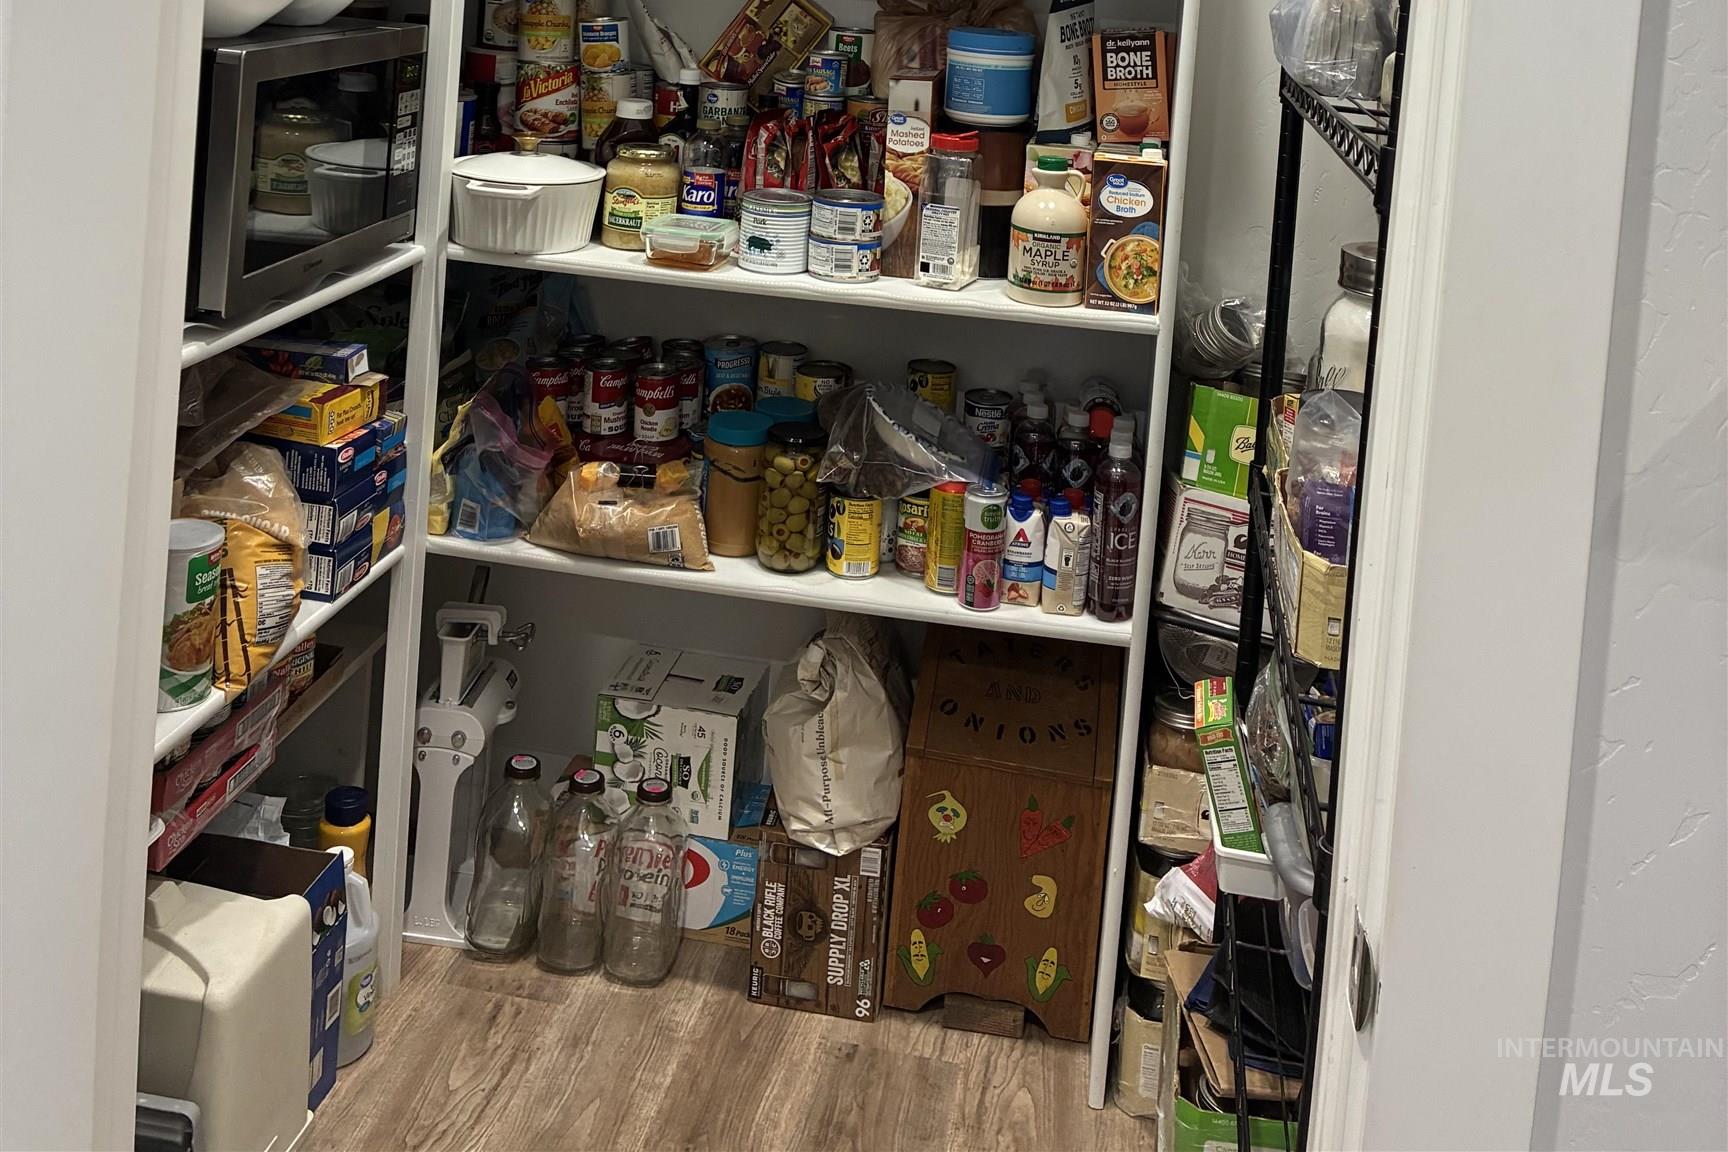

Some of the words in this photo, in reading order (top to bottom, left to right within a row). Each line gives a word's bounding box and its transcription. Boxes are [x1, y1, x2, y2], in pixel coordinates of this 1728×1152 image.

[1060, 22, 1079, 43] BONE
[838, 43, 858, 53] Beets
[1106, 39, 1117, 48] dr.
[1117, 39, 1150, 48] kellyann
[1106, 51, 1152, 67] BONE
[1107, 66, 1153, 80] BROTH
[530, 71, 574, 98] Victoria
[703, 105, 747, 115] GARBANZ
[888, 138, 924, 147] Potatoes
[891, 130, 925, 139] Mashed
[683, 184, 714, 203] Karo
[1106, 195, 1146, 207] Chicken
[1115, 205, 1136, 214] Broth
[752, 217, 768, 225] Pork
[1023, 245, 1070, 262] MAPLE
[1032, 242, 1062, 250] ORGANIC
[1030, 259, 1060, 268] SYRUP
[1107, 531, 1137, 550] ICE
[1185, 542, 1216, 559] Kerr
[984, 681, 1041, 704] AND
[940, 698, 1093, 745] ONIONS
[682, 759, 690, 781] SO
[821, 756, 834, 825] All-Purpose
[736, 849, 752, 858] Plus
[835, 875, 851, 891] XL
[765, 881, 777, 907] RIFLE
[776, 883, 786, 915] COMPANY
[832, 895, 850, 931] DROP
[725, 926, 735, 935] 18
[762, 908, 775, 938] BLACK
[774, 916, 783, 940] COFFEE
[827, 933, 847, 986] SUPPLY
[751, 967, 760, 997] KEURIG
[855, 999, 871, 1018] 96
